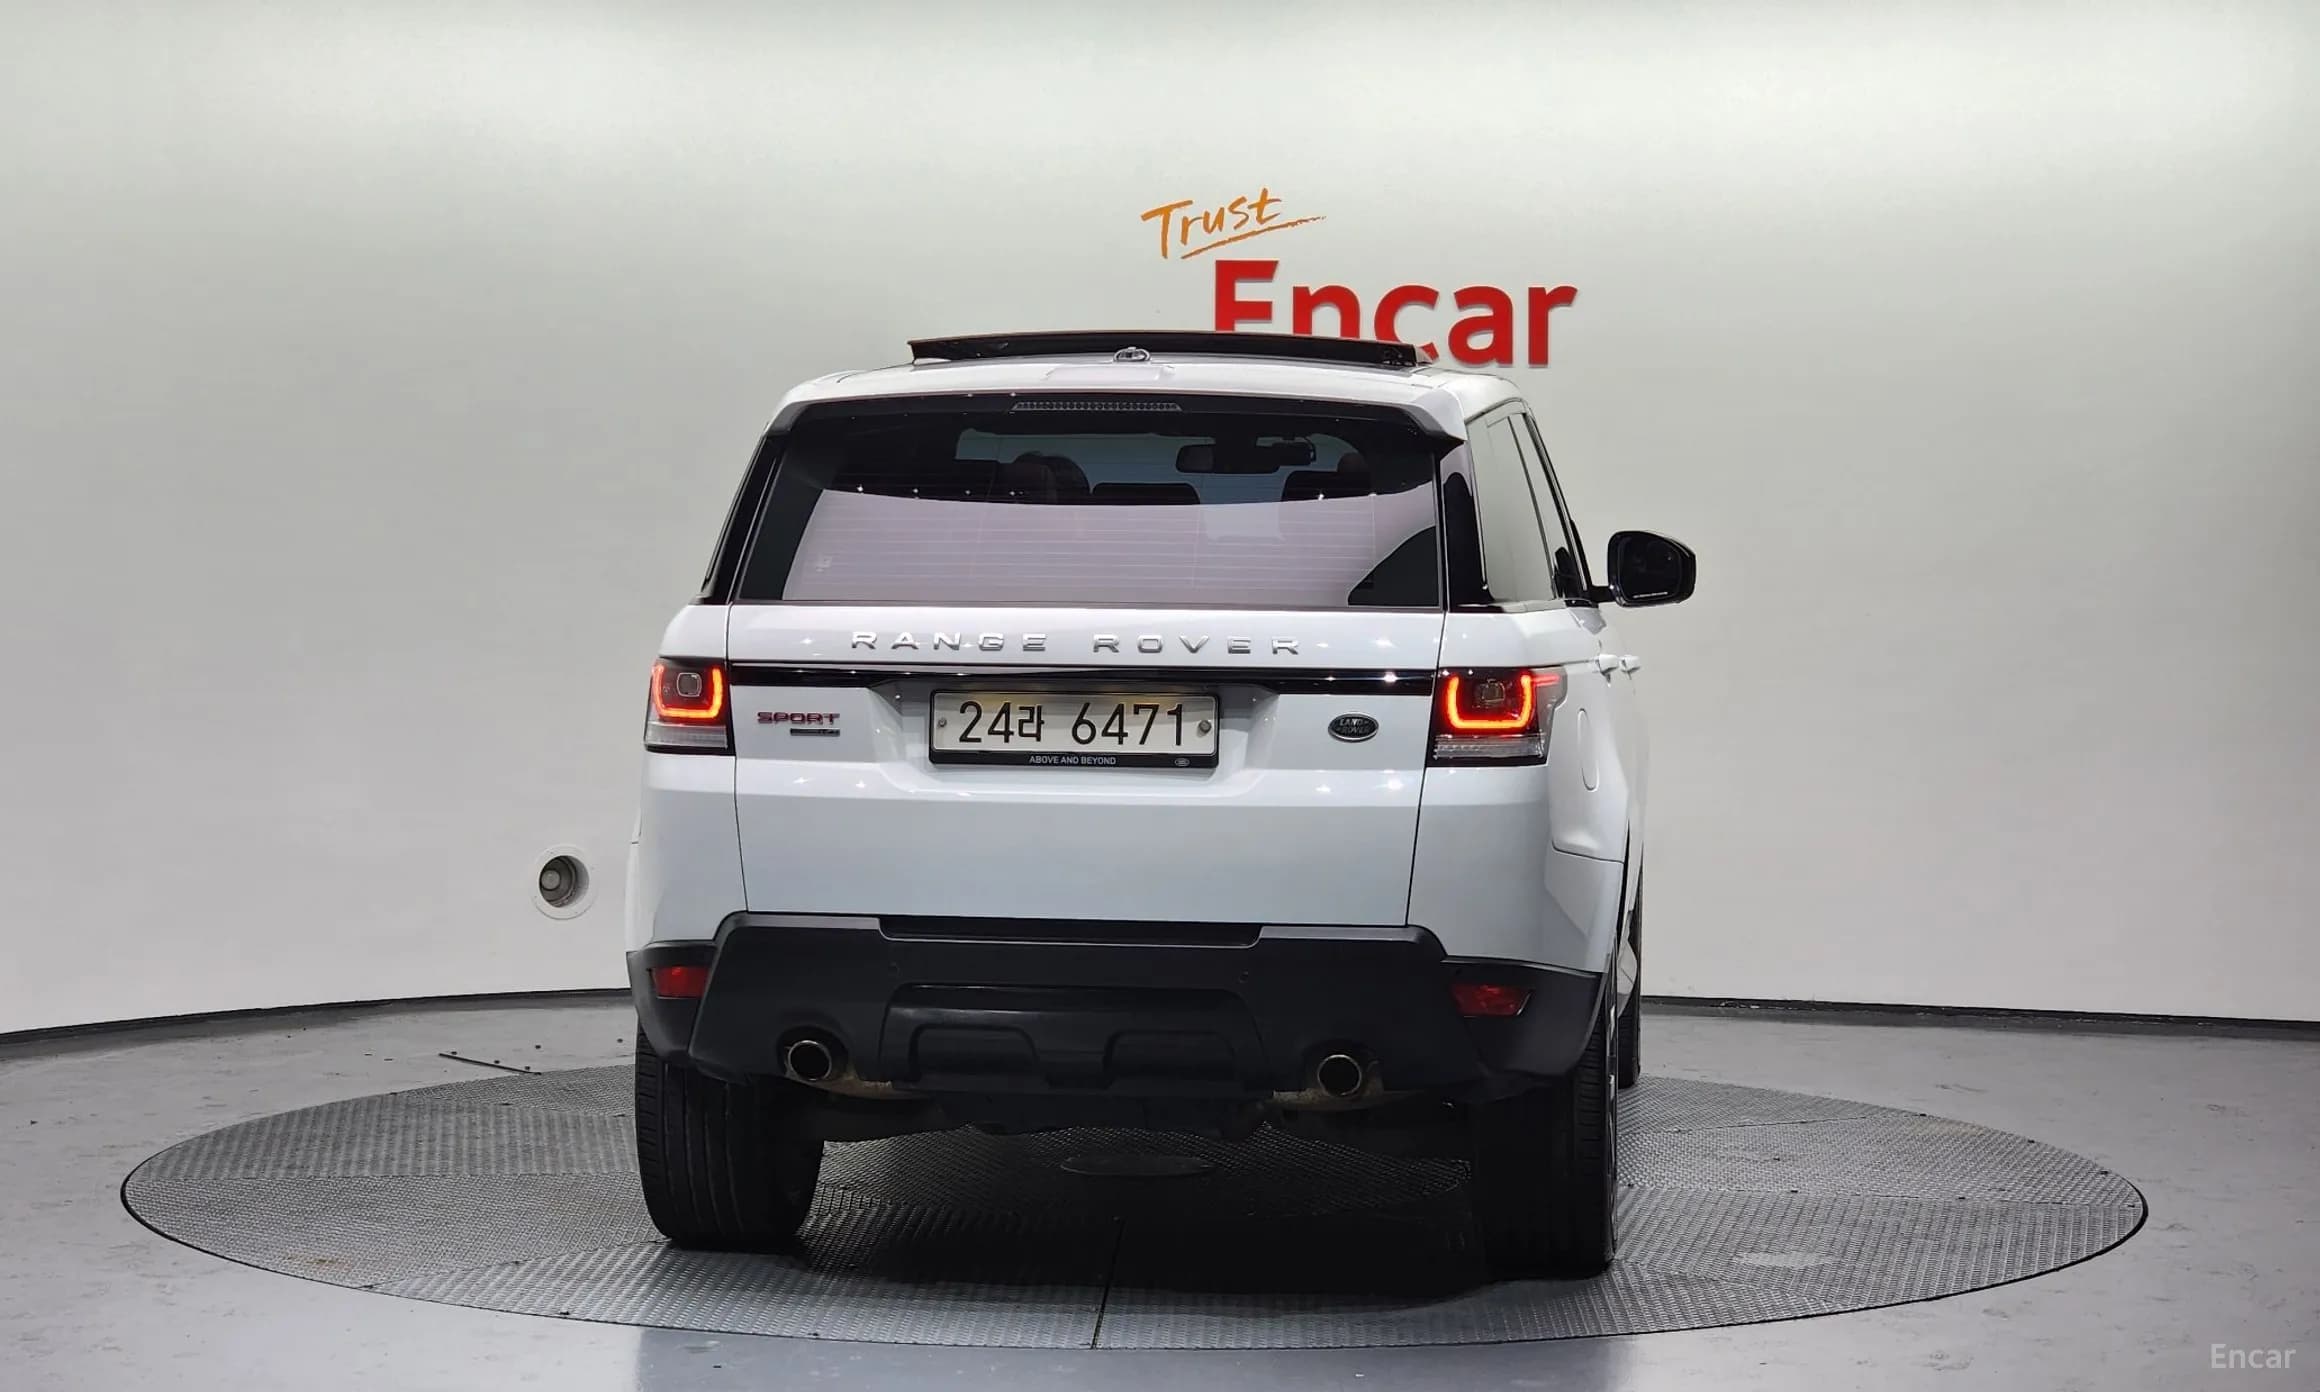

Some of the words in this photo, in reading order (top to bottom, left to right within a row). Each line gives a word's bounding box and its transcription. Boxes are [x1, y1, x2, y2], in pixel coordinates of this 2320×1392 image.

[1140, 188, 1282, 260] Trust
[1214, 260, 1578, 367] Encar
[851, 631, 1047, 652] RANGE
[1093, 634, 1300, 655] ROVER
[757, 712, 840, 725] SPORT
[959, 700, 1045, 743] 24라
[1071, 702, 1183, 746] 6471
[1029, 755, 1058, 764] ABOVE
[1060, 756, 1079, 765] AND
[1081, 756, 1116, 765] BEYOND
